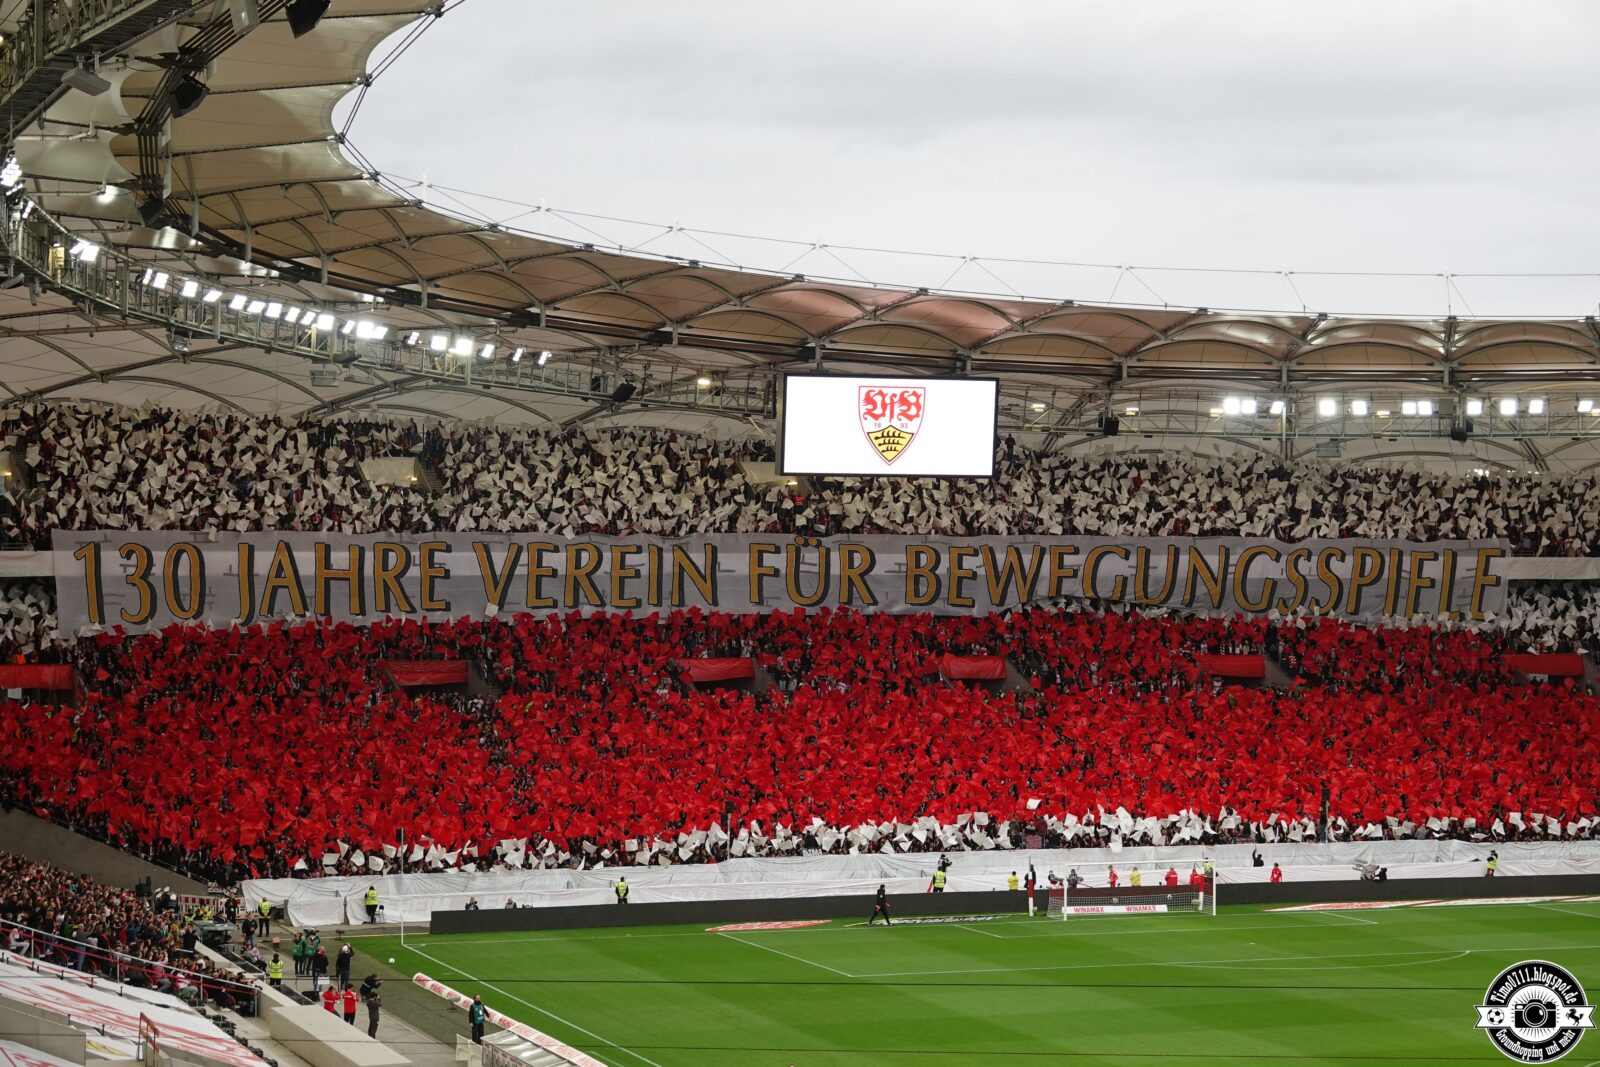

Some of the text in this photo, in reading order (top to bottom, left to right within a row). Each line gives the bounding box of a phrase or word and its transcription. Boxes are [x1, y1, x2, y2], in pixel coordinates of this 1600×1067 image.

[73, 541, 207, 624] 130
[237, 540, 453, 626] JAHRE
[472, 541, 719, 608] VEREIN
[748, 536, 878, 608] FÜR
